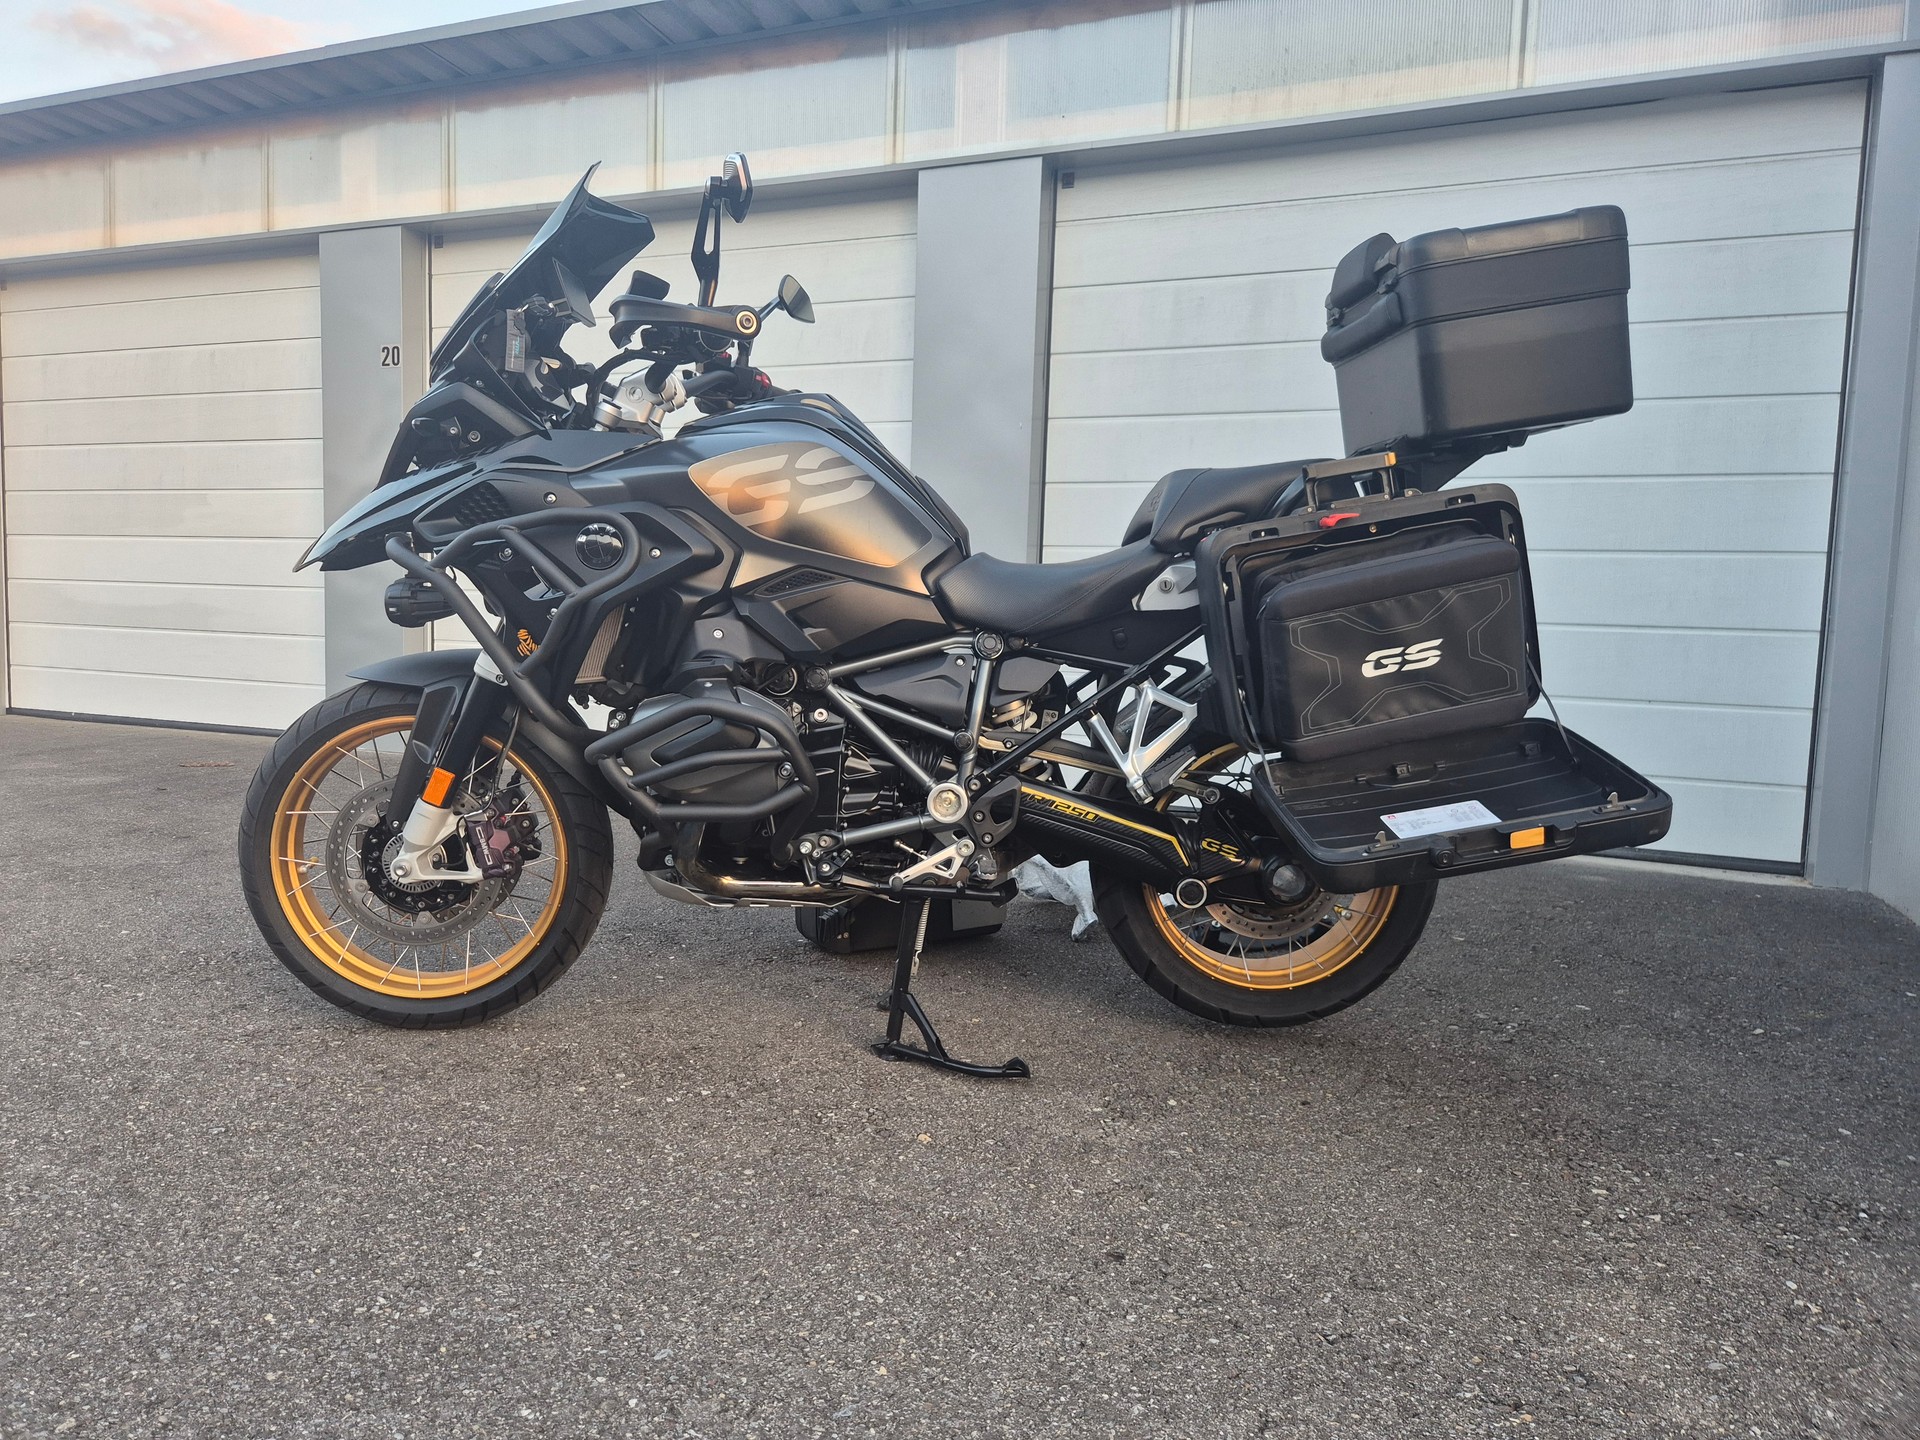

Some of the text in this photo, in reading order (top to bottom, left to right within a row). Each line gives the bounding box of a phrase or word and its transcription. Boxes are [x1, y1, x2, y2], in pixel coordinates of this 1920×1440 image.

[381, 346, 400, 367] 20
[707, 446, 876, 527] GS
[1361, 638, 1443, 678] GS
[479, 838, 490, 855] BMW
[1201, 838, 1240, 859] GS
